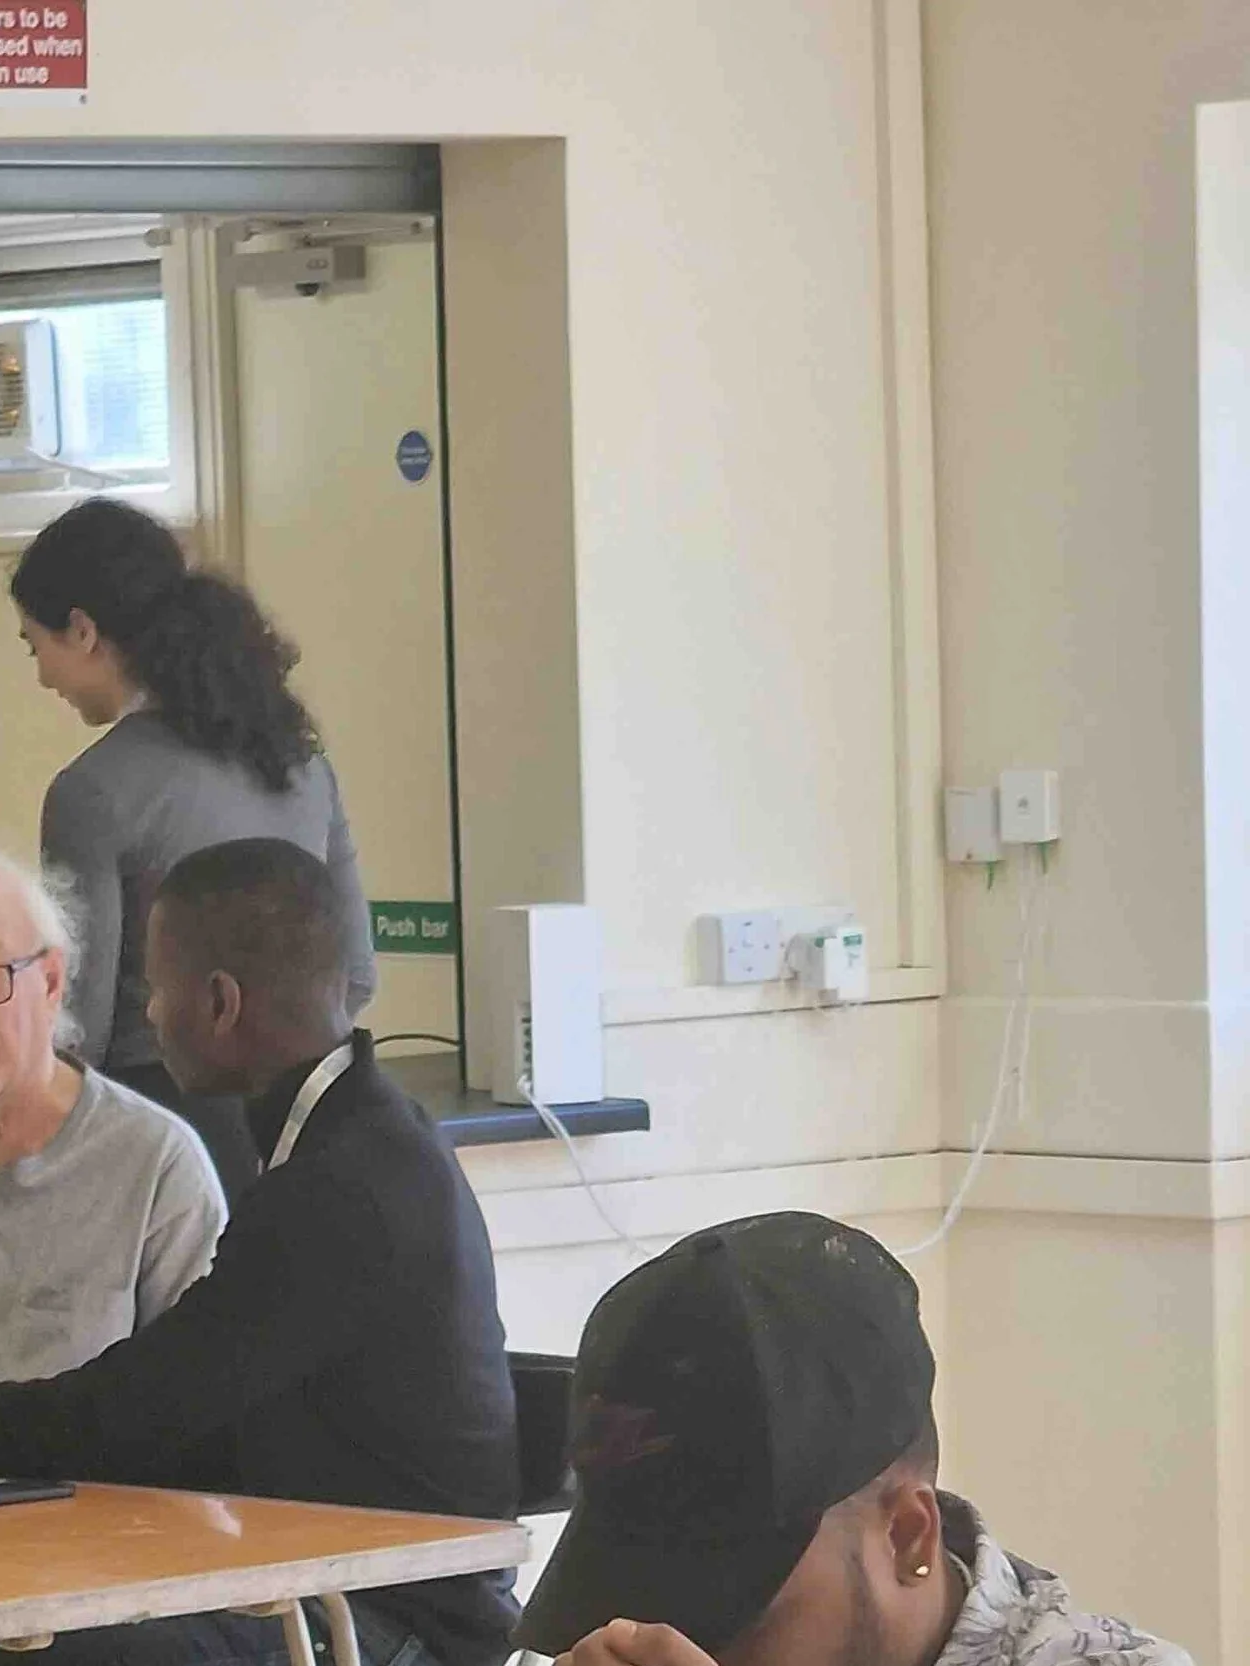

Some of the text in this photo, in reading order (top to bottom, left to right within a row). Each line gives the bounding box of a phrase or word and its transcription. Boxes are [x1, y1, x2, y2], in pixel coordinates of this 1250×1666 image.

[19, 7, 40, 29] to
[43, 7, 68, 29] be
[33, 36, 83, 57] when
[14, 65, 49, 84] use
[376, 915, 449, 939] Push bar
